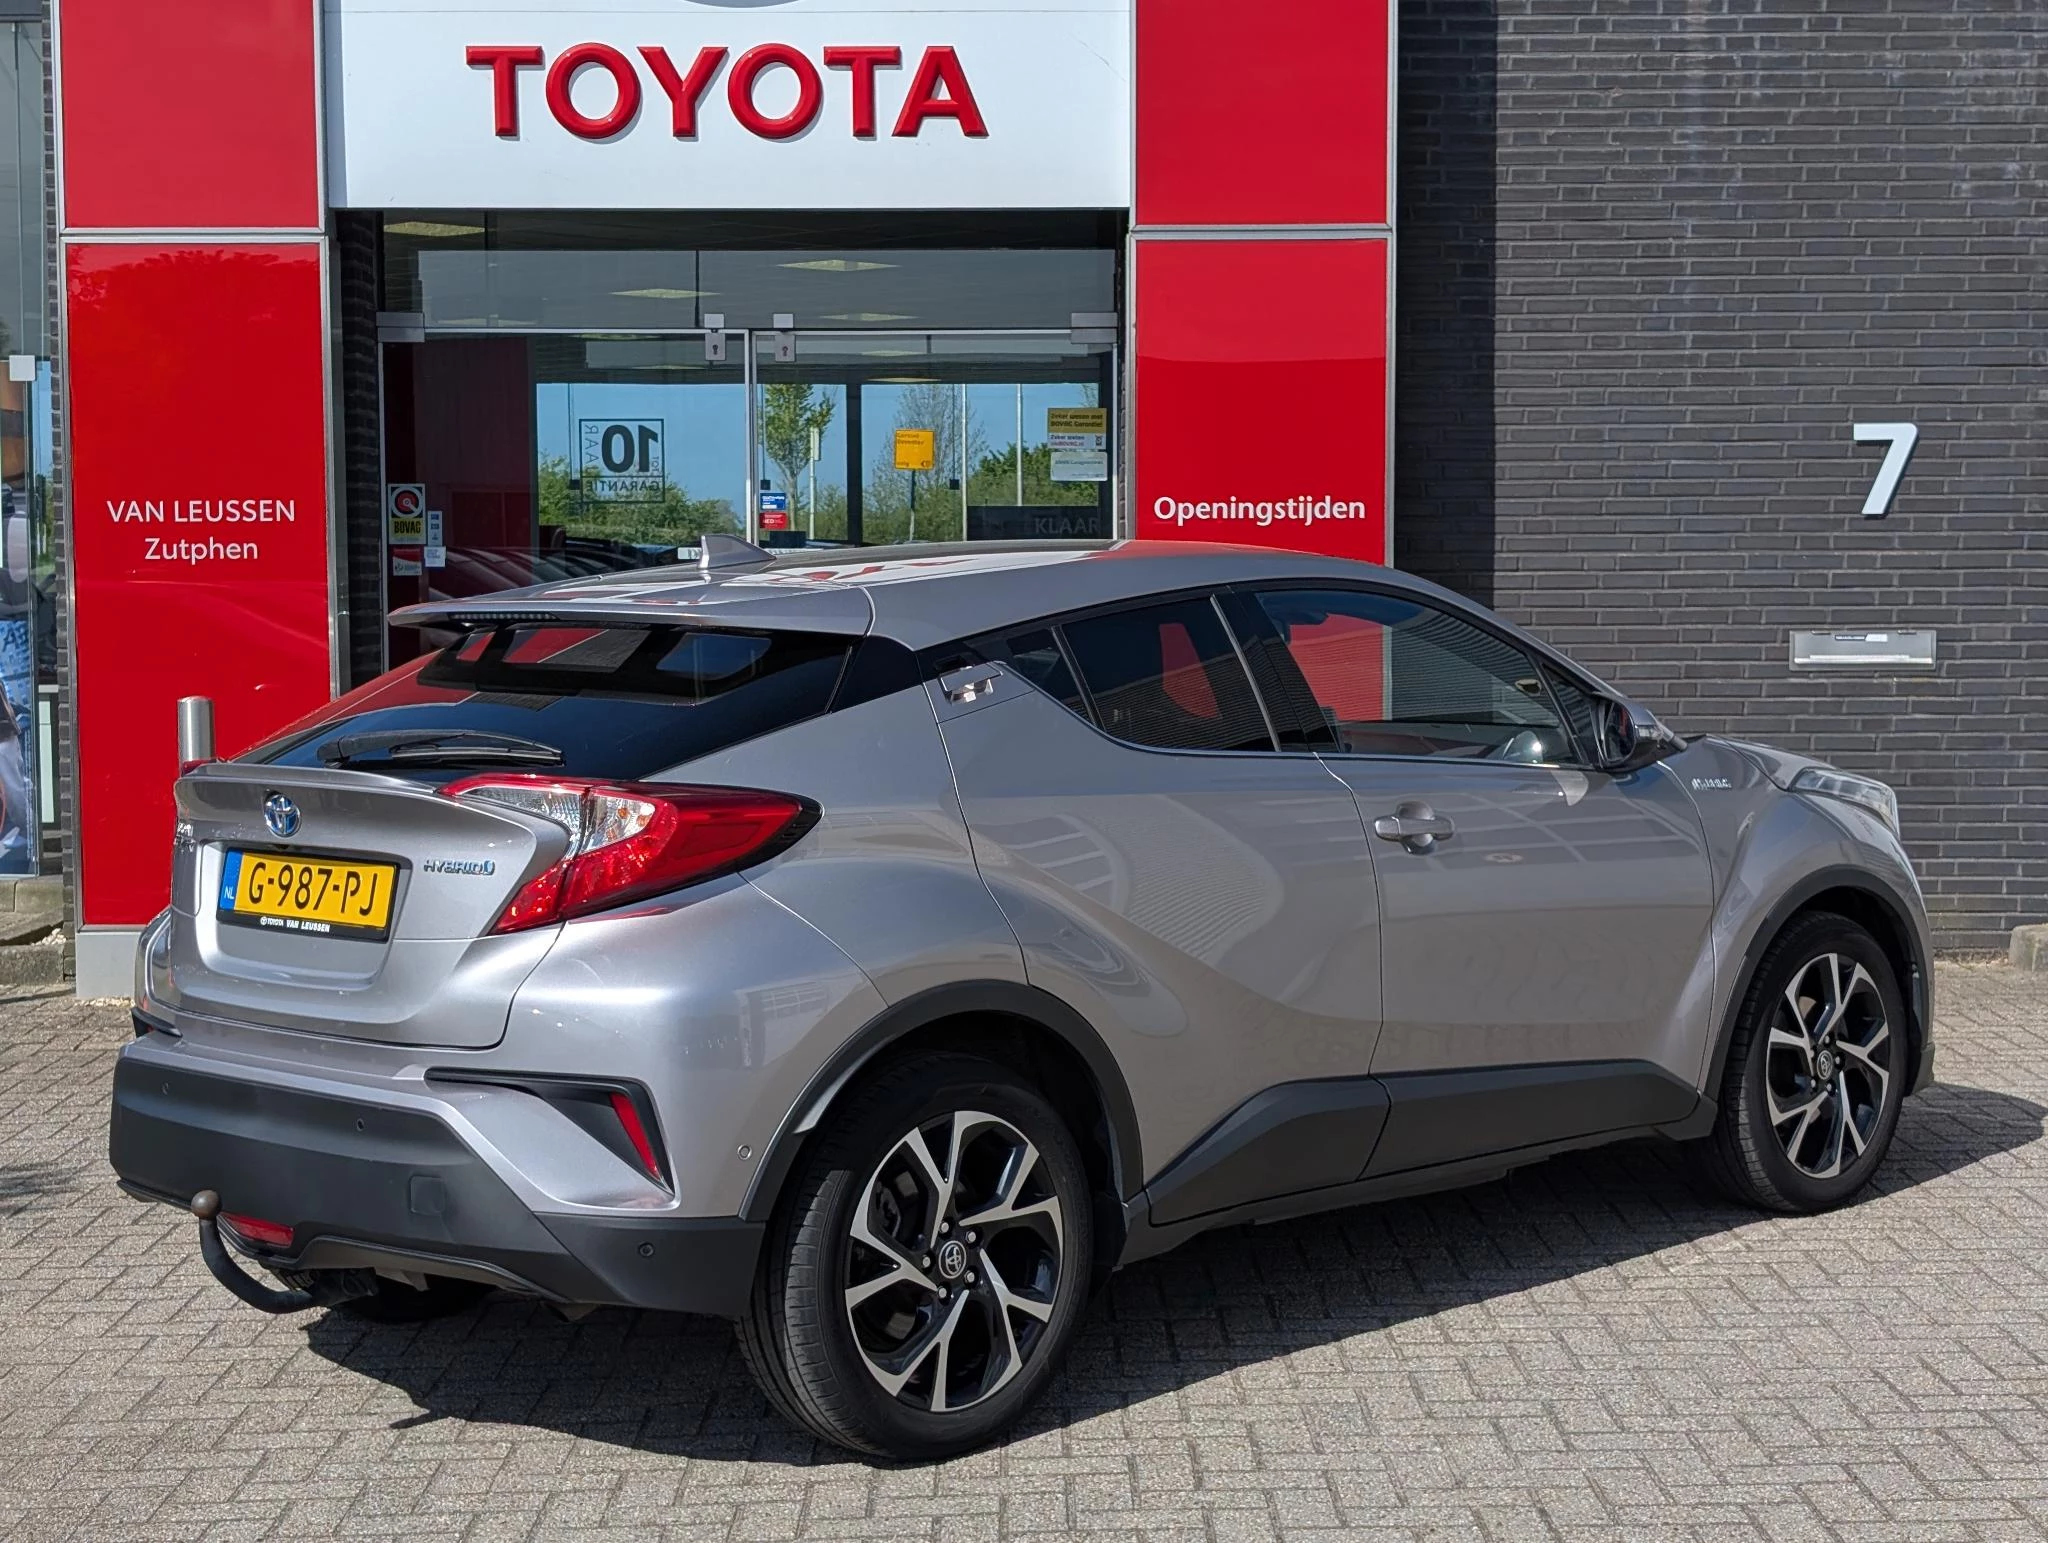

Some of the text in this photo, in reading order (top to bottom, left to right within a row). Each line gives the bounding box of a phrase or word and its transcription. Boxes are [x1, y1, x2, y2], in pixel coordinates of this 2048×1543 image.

[466, 44, 988, 138] TOYOTA
[1854, 423, 1917, 515] 7
[106, 499, 297, 523] VAN LEUSSEN
[1153, 495, 1366, 528] Openingstijden
[394, 521, 421, 534] BOVAG
[144, 536, 259, 565] Zutphen
[223, 886, 235, 900] NL
[248, 861, 378, 917] G-987-PJ
[286, 918, 299, 929] VAN
[300, 921, 331, 933] LEUSSEN
